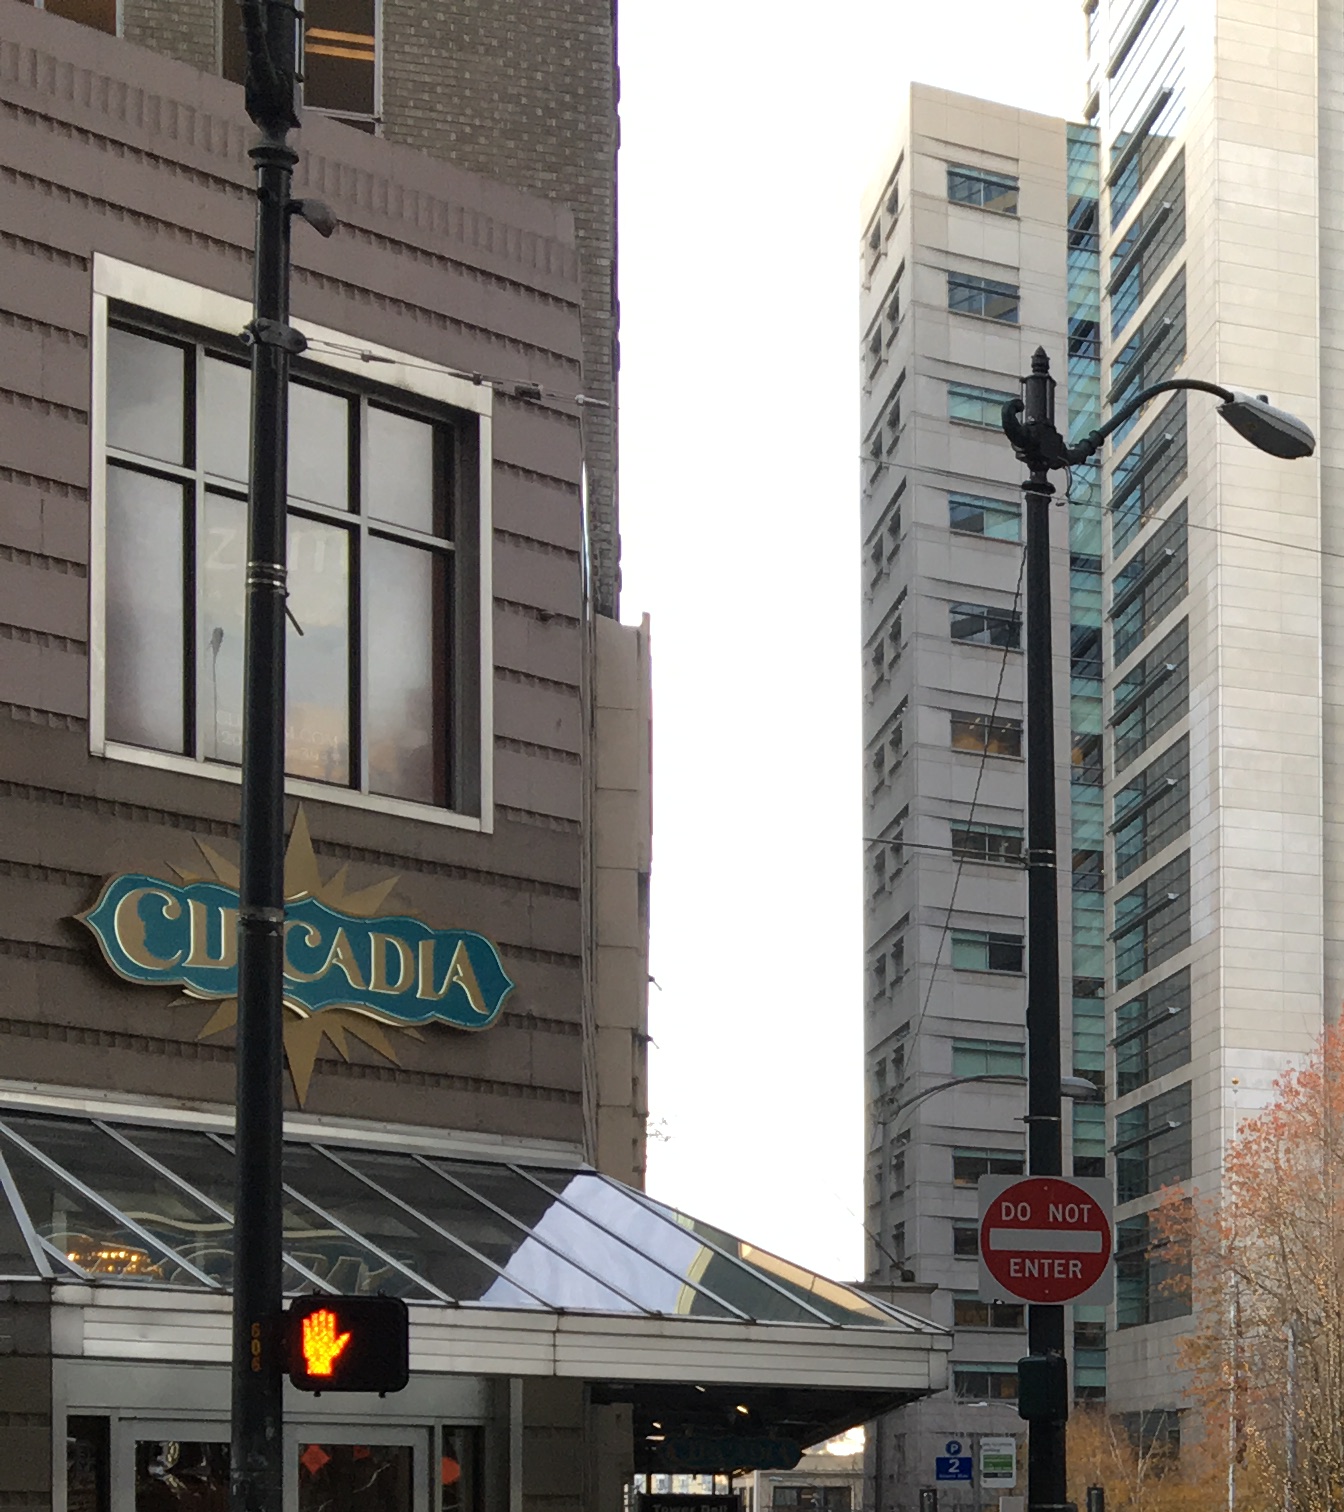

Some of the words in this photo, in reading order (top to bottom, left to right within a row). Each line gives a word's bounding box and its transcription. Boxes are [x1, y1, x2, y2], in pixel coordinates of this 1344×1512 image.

[1001, 1202, 1031, 1222] DO
[1048, 1203, 1092, 1223] NOT
[1009, 1258, 1082, 1280] ENTER
[948, 1459, 960, 1473] 2
